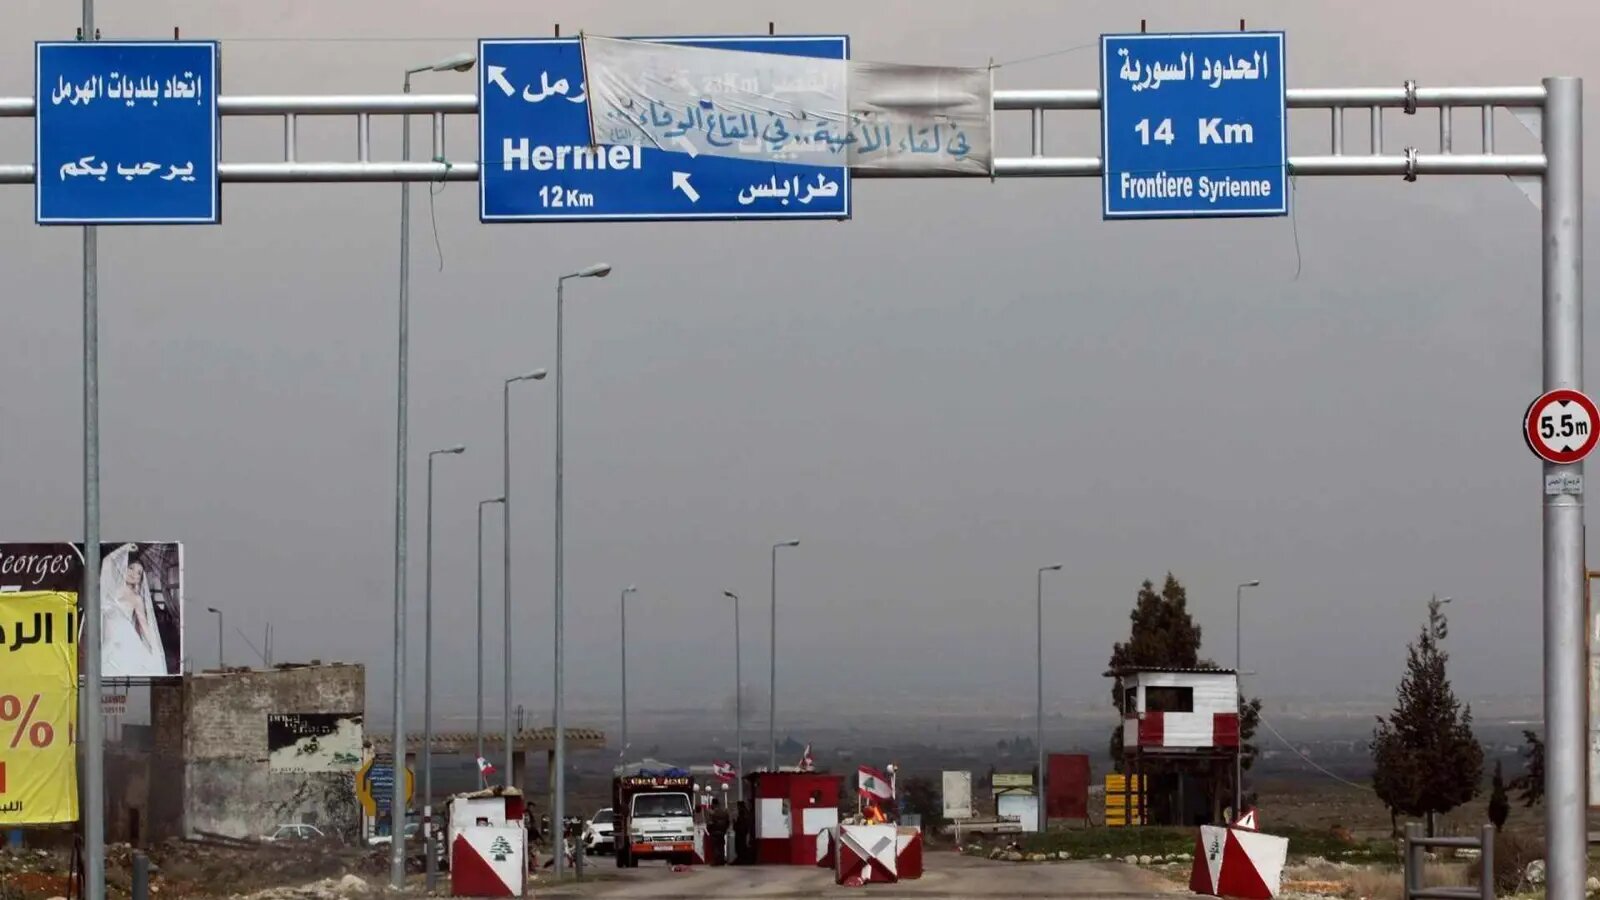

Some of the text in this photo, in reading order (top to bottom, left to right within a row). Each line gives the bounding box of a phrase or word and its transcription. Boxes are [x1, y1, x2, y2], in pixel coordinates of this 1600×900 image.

[1117, 48, 1268, 91] الحدود السورية
[52, 71, 202, 107] إتحاد بلديات الهرمل
[1134, 118, 1253, 145] 14 Km
[60, 156, 197, 181] يرحب بكم
[503, 137, 641, 171] Hermel
[738, 173, 838, 205] طرابلس
[1120, 171, 1271, 203] Frontiere Syrienne
[0, 549, 72, 584] eorges
